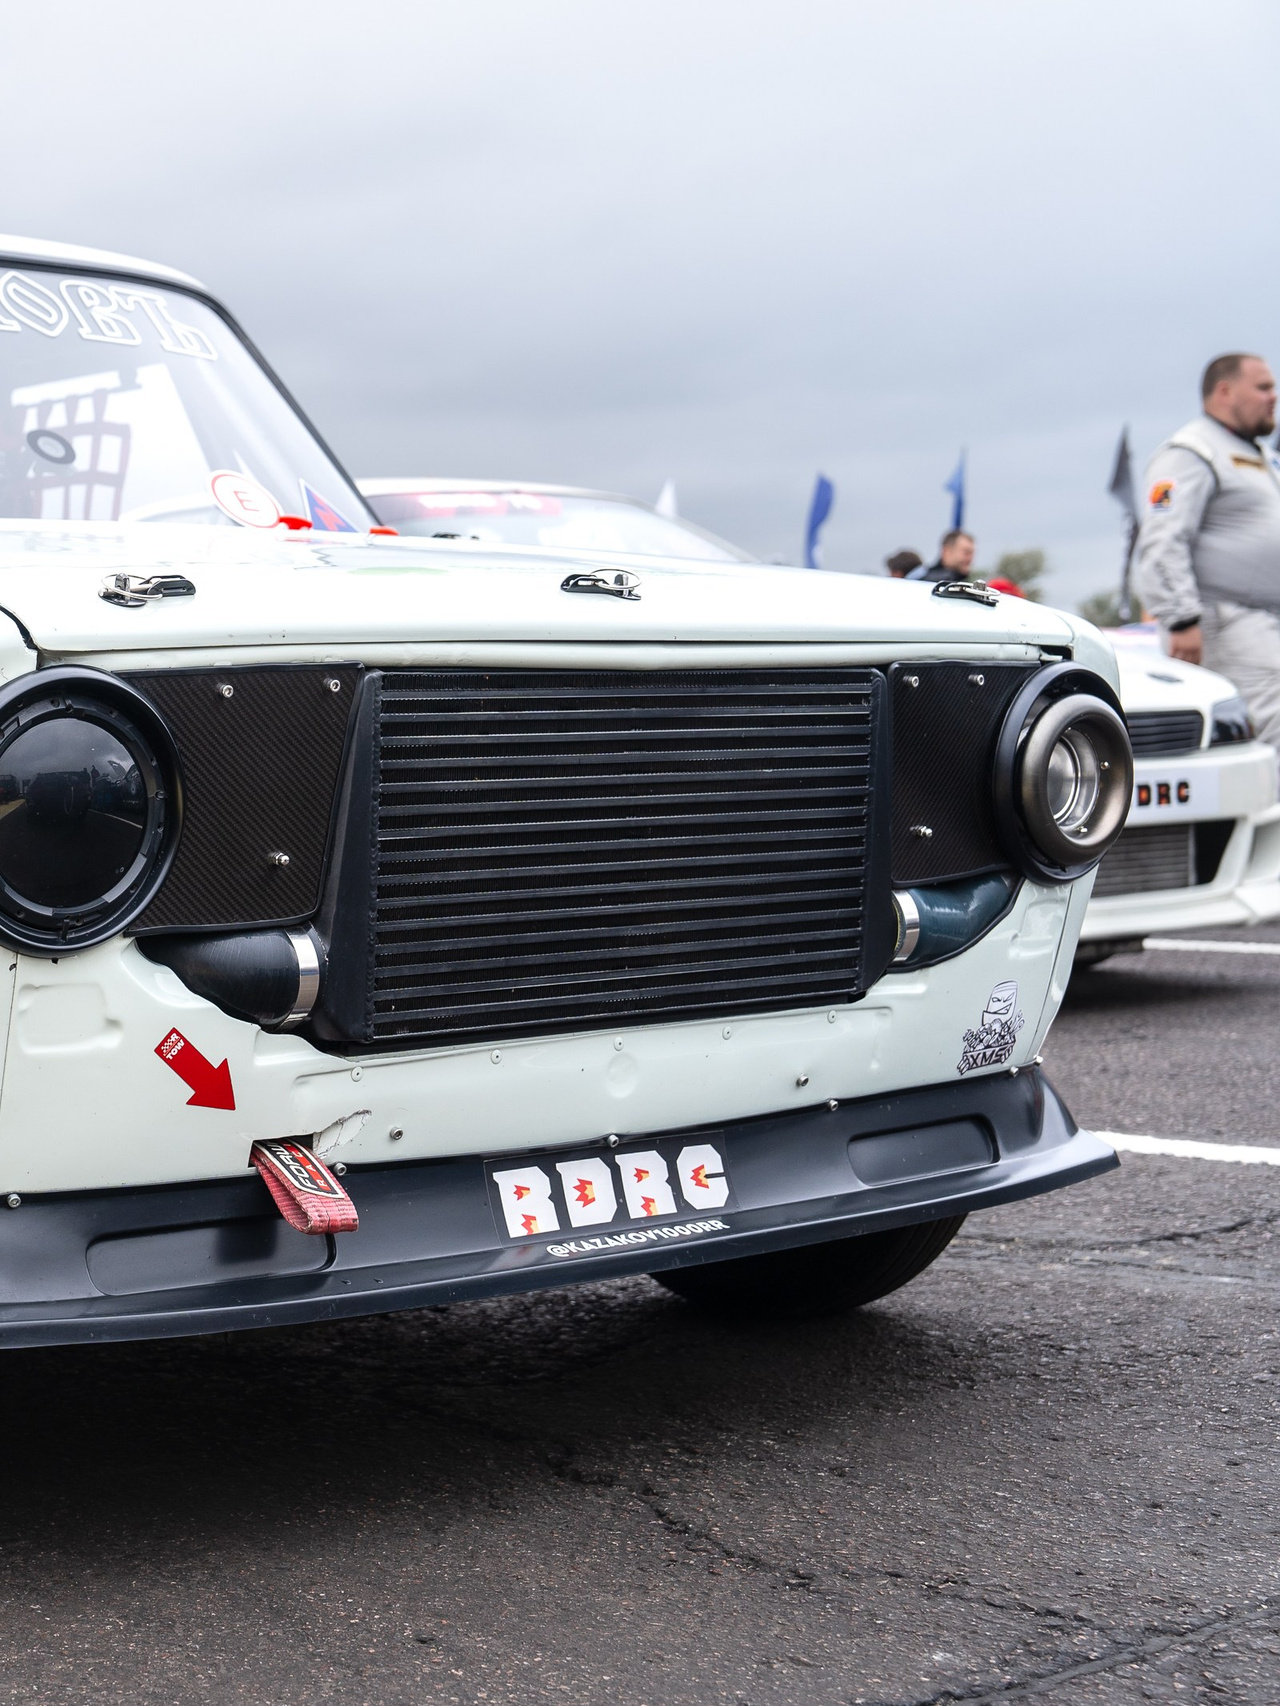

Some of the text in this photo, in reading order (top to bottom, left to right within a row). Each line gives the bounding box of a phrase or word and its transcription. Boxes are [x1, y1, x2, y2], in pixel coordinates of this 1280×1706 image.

[233, 490, 260, 512] E
[1136, 781, 1190, 807] DRC
[165, 1039, 185, 1060] TOW
[492, 1143, 730, 1239] RDRC
[546, 1219, 731, 1258] @KAZAKOV1000RR
